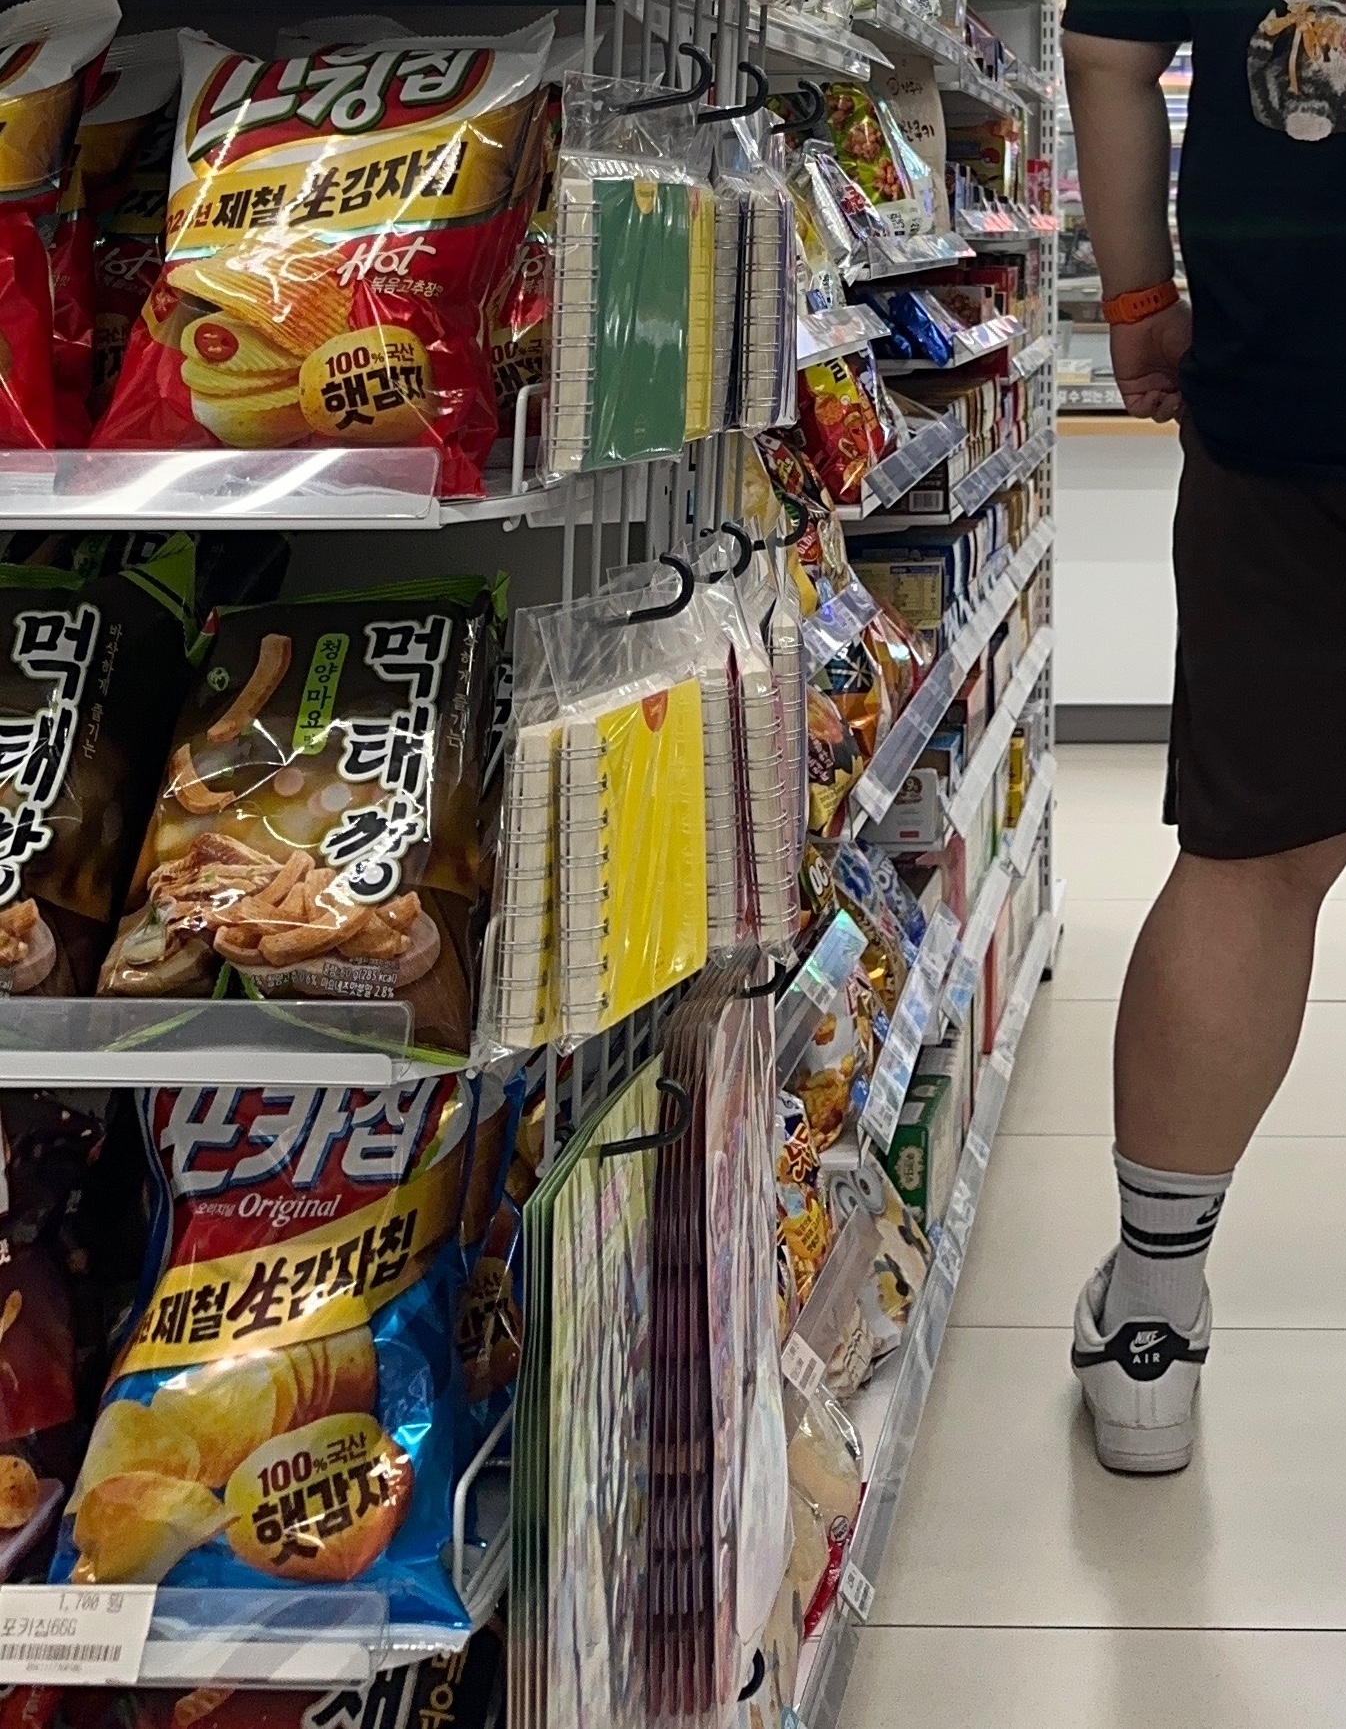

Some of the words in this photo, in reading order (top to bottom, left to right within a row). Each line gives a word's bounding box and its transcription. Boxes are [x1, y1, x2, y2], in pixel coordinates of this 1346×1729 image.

[211, 184, 287, 230] 제철
[337, 236, 437, 287] Hot
[324, 344, 385, 378] 100%
[385, 342, 414, 363] 국산
[320, 365, 426, 431] 햇감자
[238, 1192, 342, 1227] Original
[151, 1281, 231, 1346] 제철
[1132, 1352, 1161, 1365] AIR
[257, 1451, 328, 1499] 100%
[327, 1431, 368, 1465] 국산
[252, 1456, 390, 1567] 햇감자
